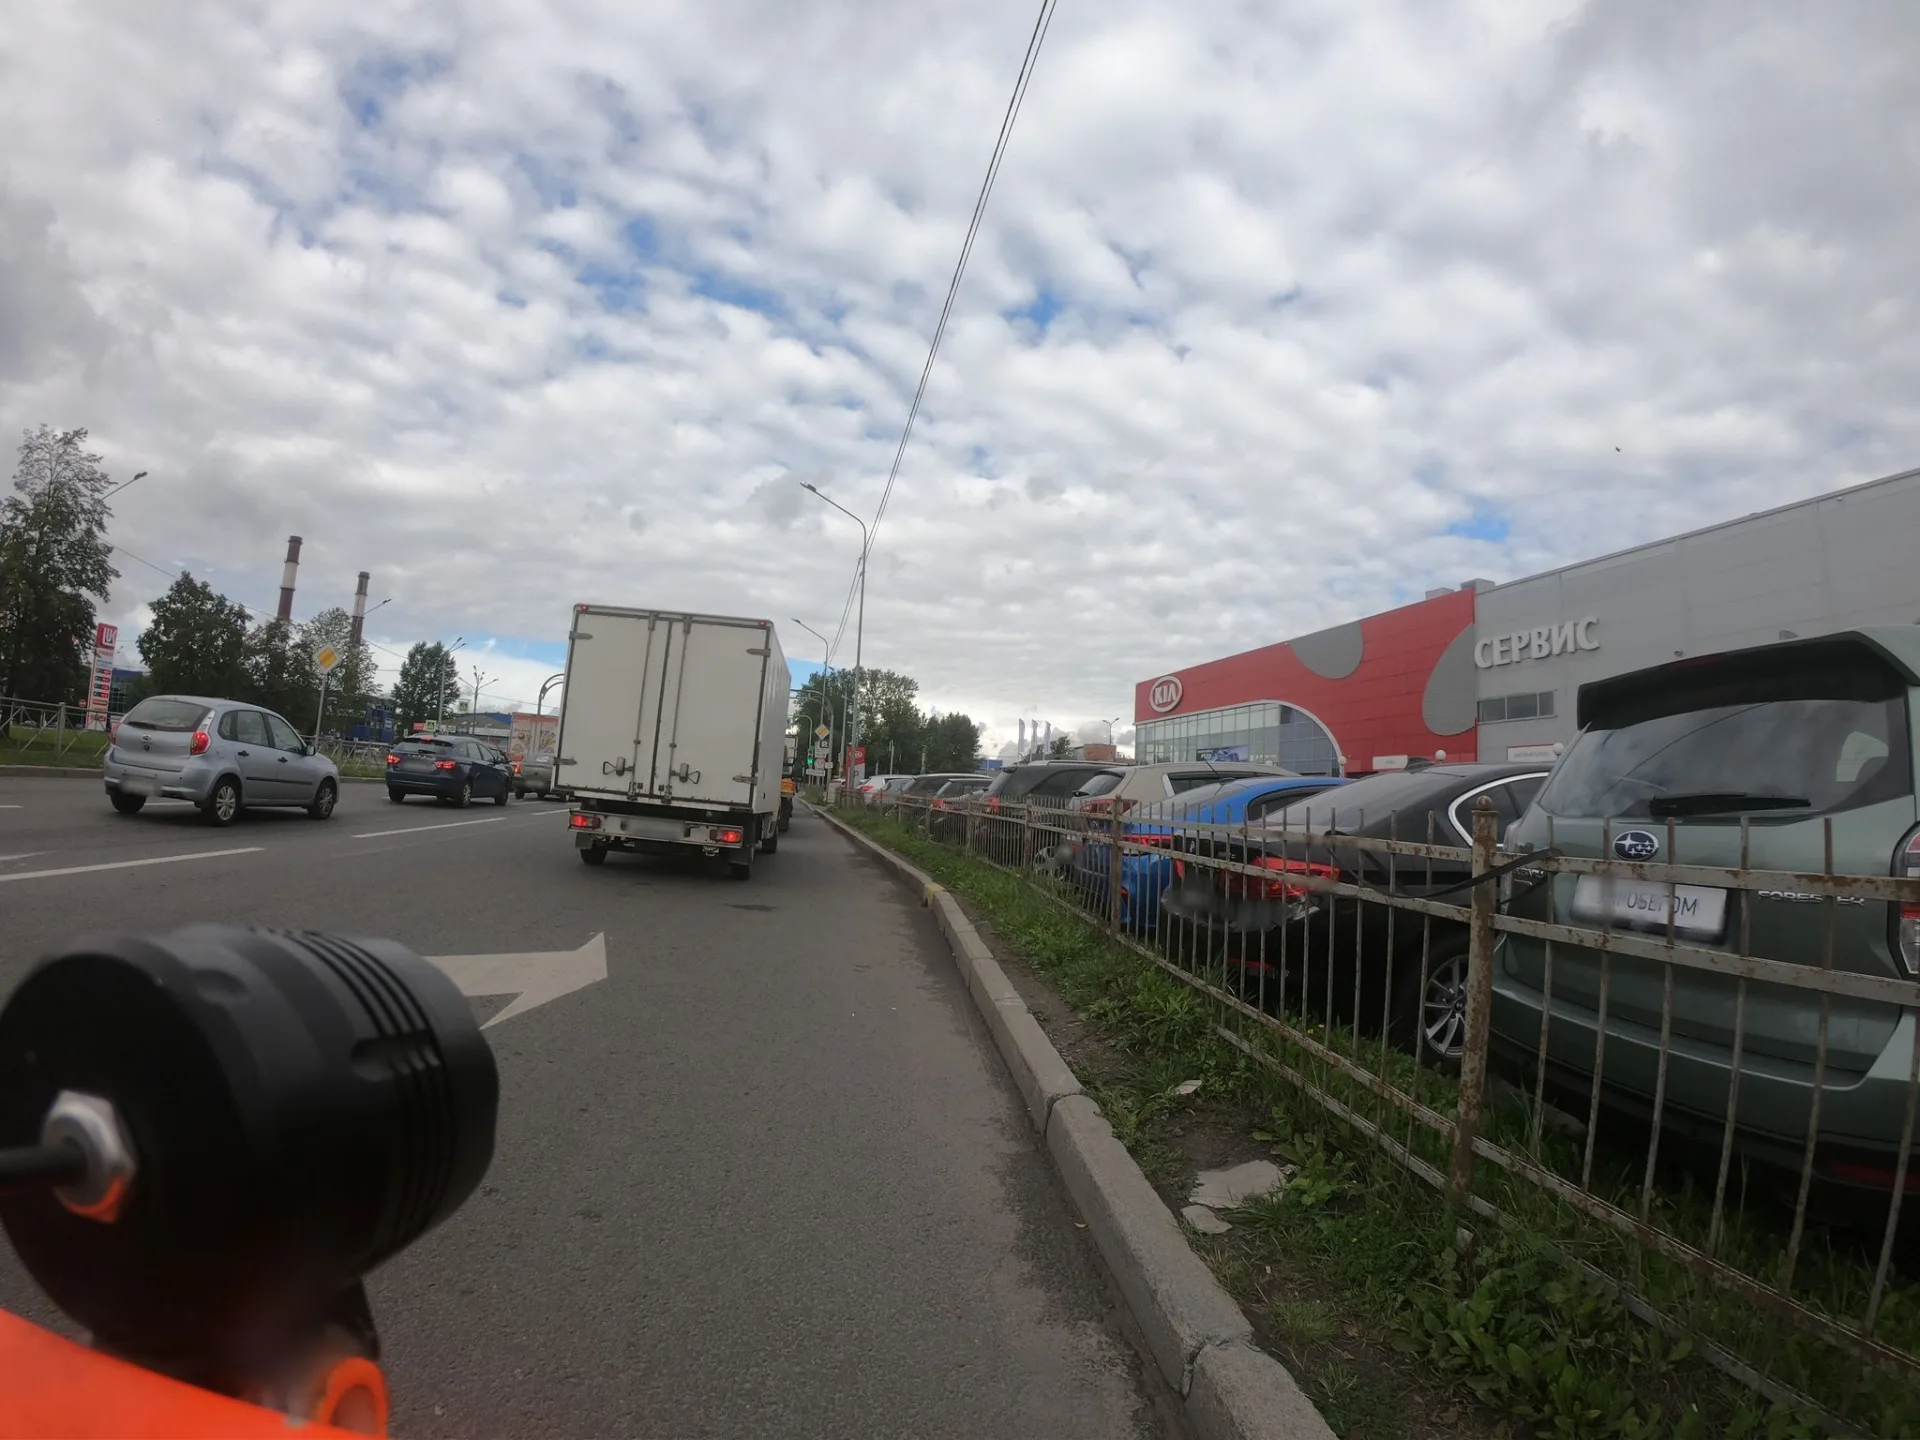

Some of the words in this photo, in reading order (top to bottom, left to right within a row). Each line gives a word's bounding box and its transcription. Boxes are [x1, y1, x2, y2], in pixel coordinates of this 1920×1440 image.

[1474, 615, 1600, 669] СЕРВИС
[1153, 681, 1177, 704] KIA
[1758, 890, 1864, 906] FORESER
